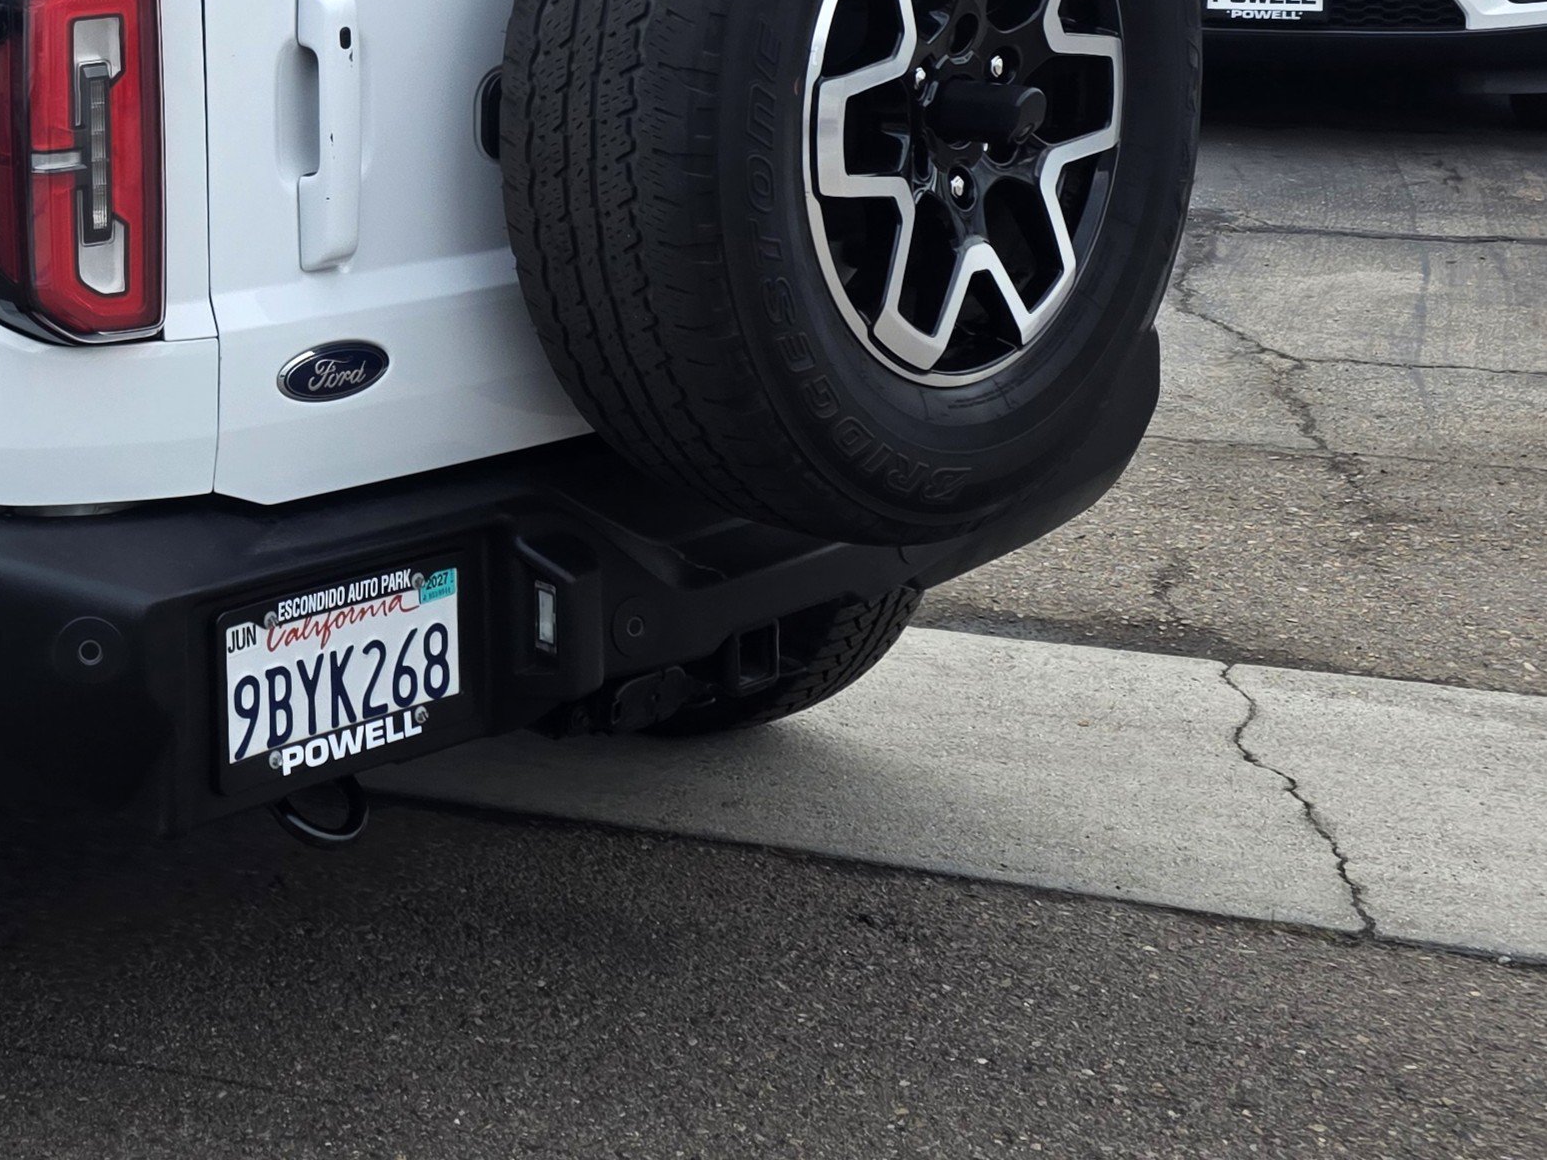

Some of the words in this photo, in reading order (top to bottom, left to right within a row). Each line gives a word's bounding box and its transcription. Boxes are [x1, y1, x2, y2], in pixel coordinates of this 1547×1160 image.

[1230, 10, 1301, 20] POWELL
[747, 20, 972, 504] BRIDGESTONE
[308, 357, 367, 392] Ford
[277, 588, 345, 621] ESCONDIDO
[347, 578, 379, 601] AUTO
[380, 568, 411, 591] PARK
[425, 571, 449, 590] 2027
[227, 624, 257, 654] JUN
[267, 592, 420, 652] California
[233, 622, 450, 762] 9BYK268
[281, 710, 423, 776] POWELL
